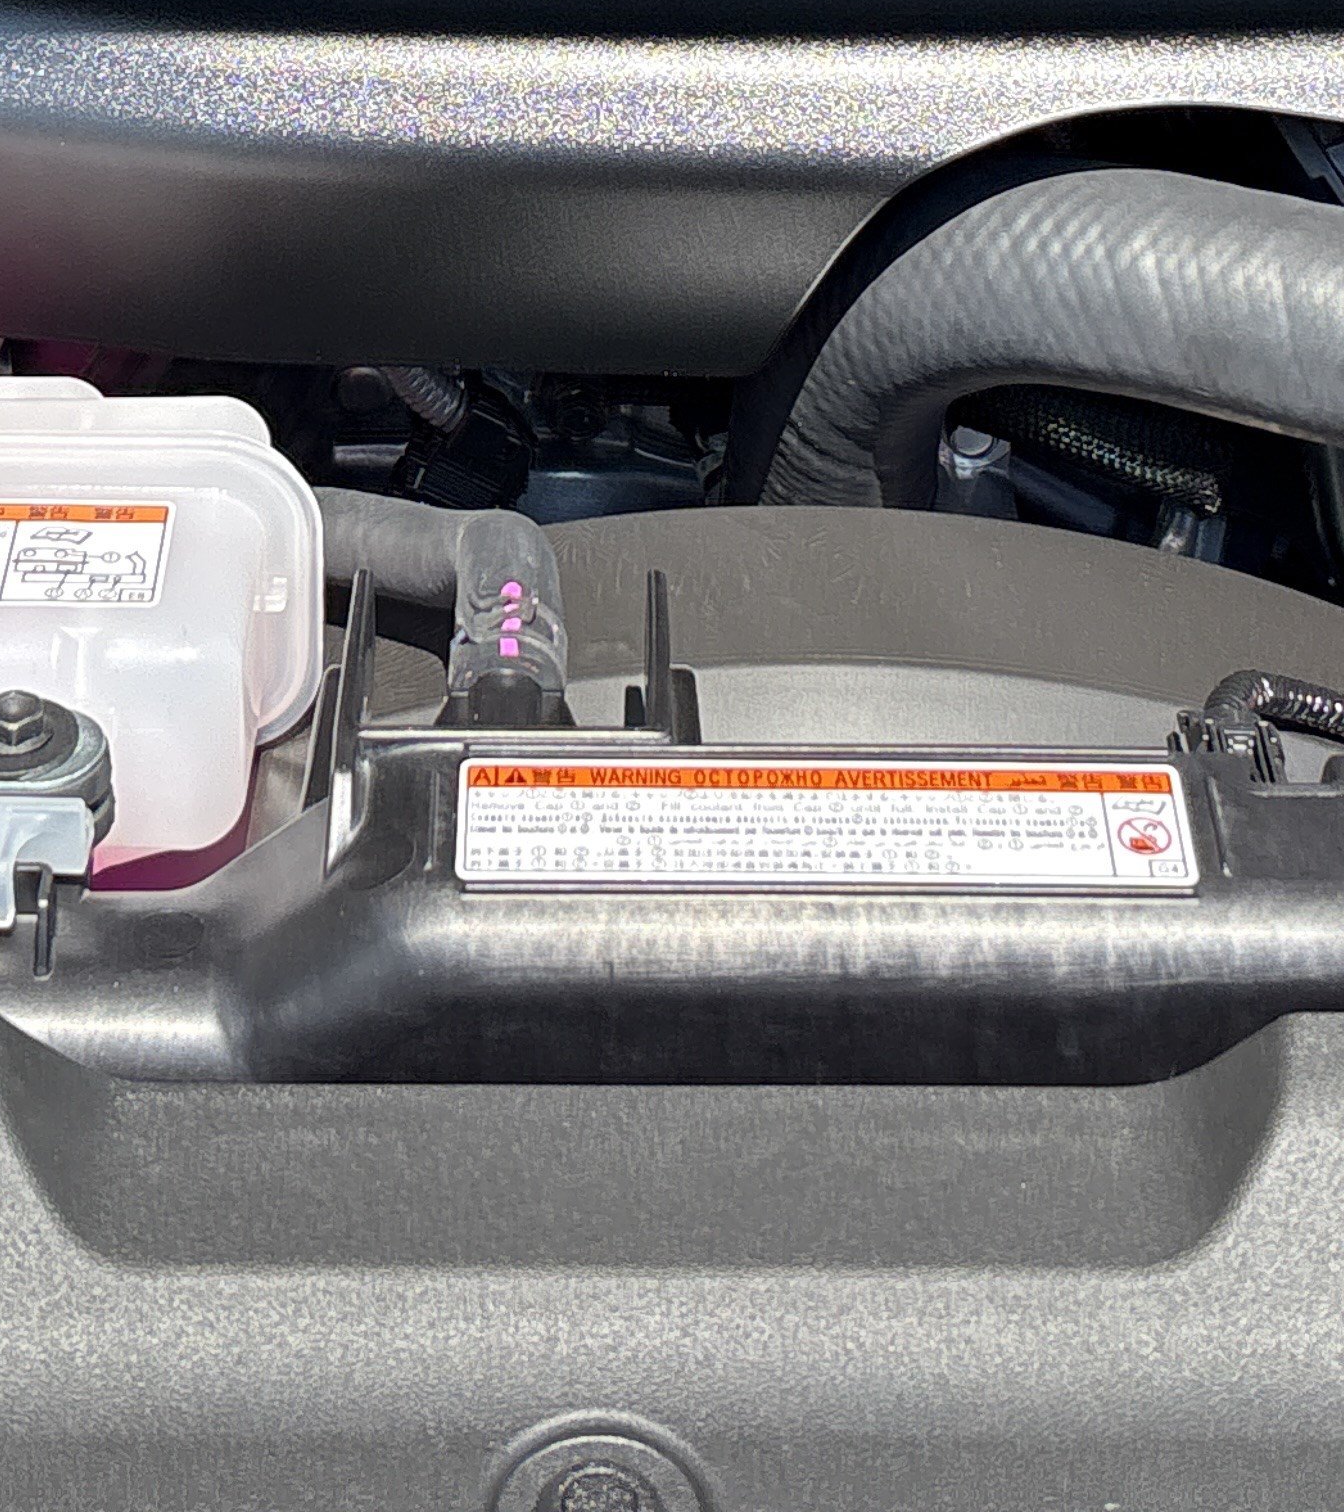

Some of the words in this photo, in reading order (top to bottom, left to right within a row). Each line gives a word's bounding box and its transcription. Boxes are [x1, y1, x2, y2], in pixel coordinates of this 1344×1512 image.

[473, 768, 492, 785] A
[589, 769, 682, 785] WARNING
[693, 769, 823, 787] ОСТОРОЖНО
[834, 770, 992, 788] AVERTISSEMENT
